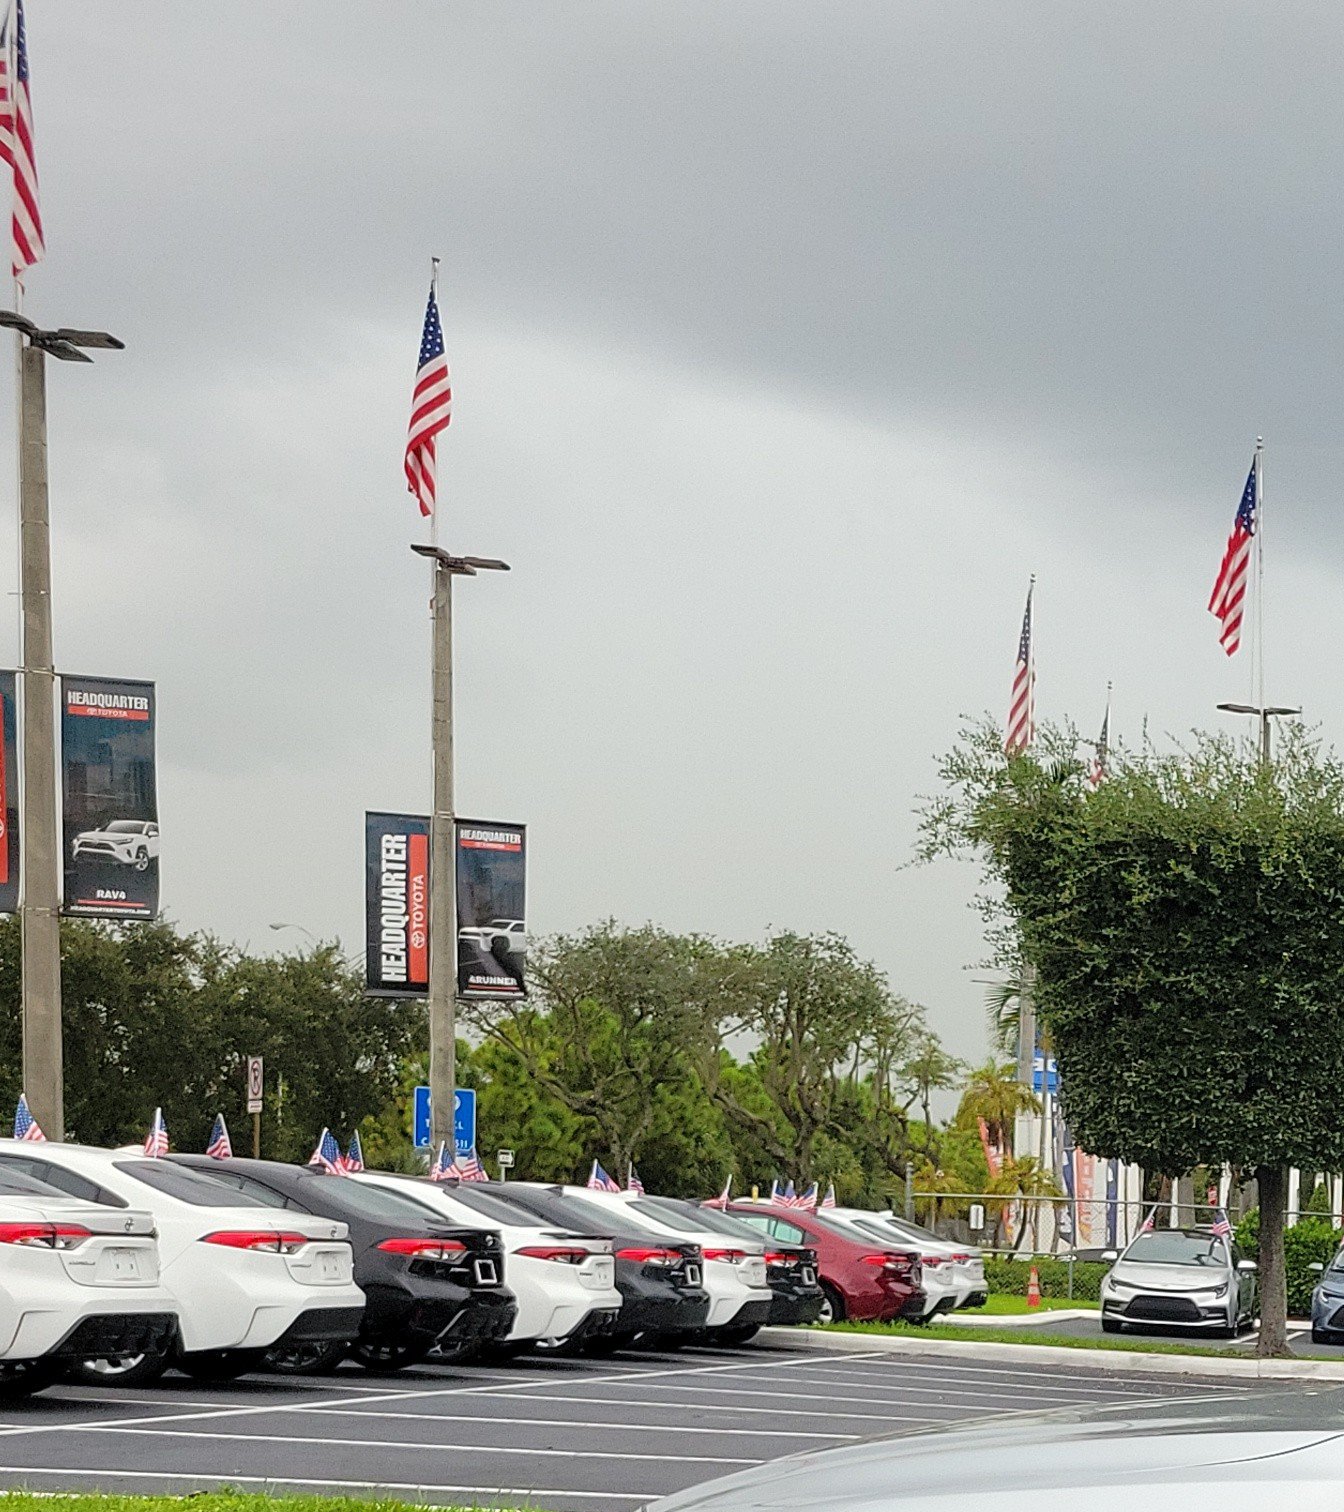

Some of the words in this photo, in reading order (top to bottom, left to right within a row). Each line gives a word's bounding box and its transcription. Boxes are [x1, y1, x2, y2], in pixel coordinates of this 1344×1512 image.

[67, 690, 149, 710] HEADQUARTER
[98, 708, 128, 717] TOYOTA
[460, 829, 521, 844] HEADQUARTER
[96, 889, 127, 900] RAV4
[413, 874, 424, 929] TOYOTA
[381, 833, 409, 982] HEADQUARTER
